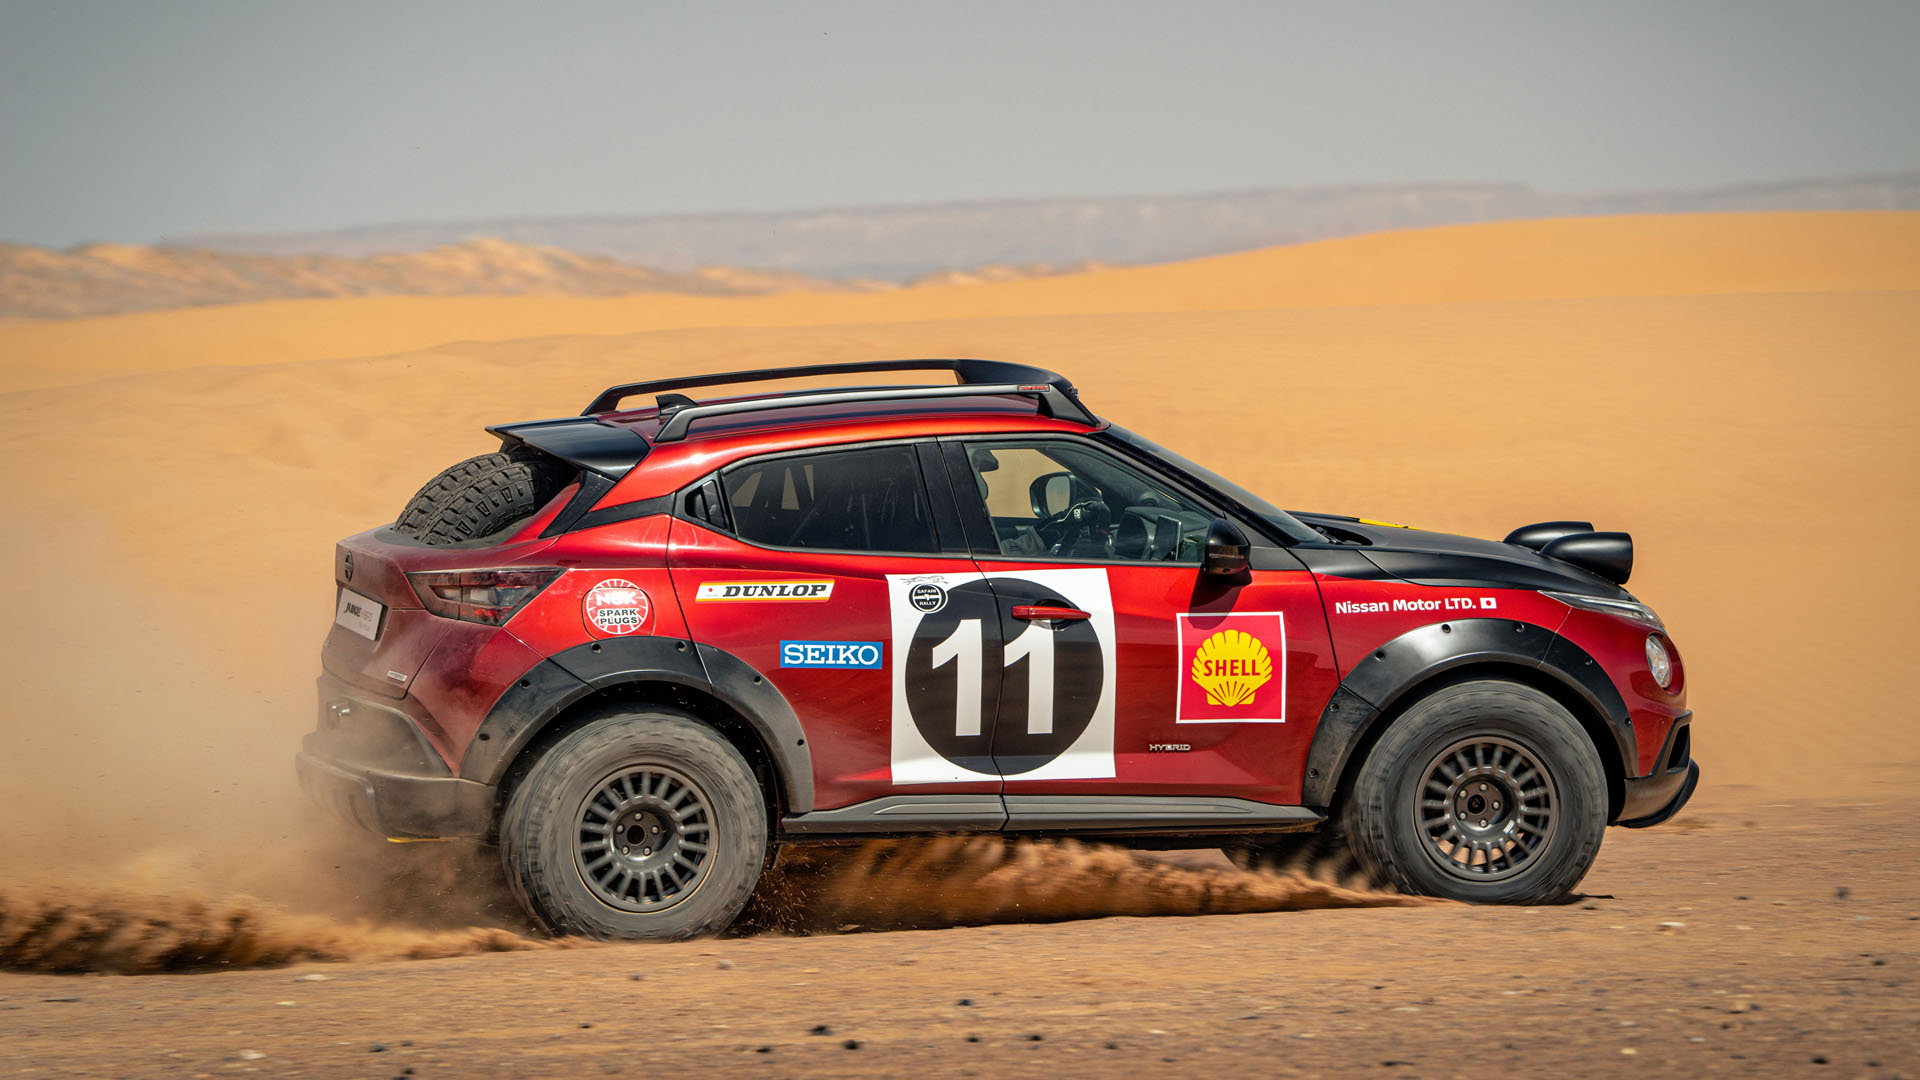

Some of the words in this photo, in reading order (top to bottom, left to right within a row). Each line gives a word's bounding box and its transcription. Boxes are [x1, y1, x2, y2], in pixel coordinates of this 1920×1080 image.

[722, 584, 827, 598] DUNLOP
[599, 608, 637, 617] SPARK
[1335, 600, 1389, 614] Nissan
[1393, 599, 1441, 612] Motor
[1444, 598, 1477, 610] LTD.
[600, 617, 638, 625] PLUGS
[784, 643, 879, 666] SEIKO
[1203, 659, 1261, 677] SHELL
[932, 617, 1055, 737] 11
[1148, 743, 1191, 751] HYBRID
